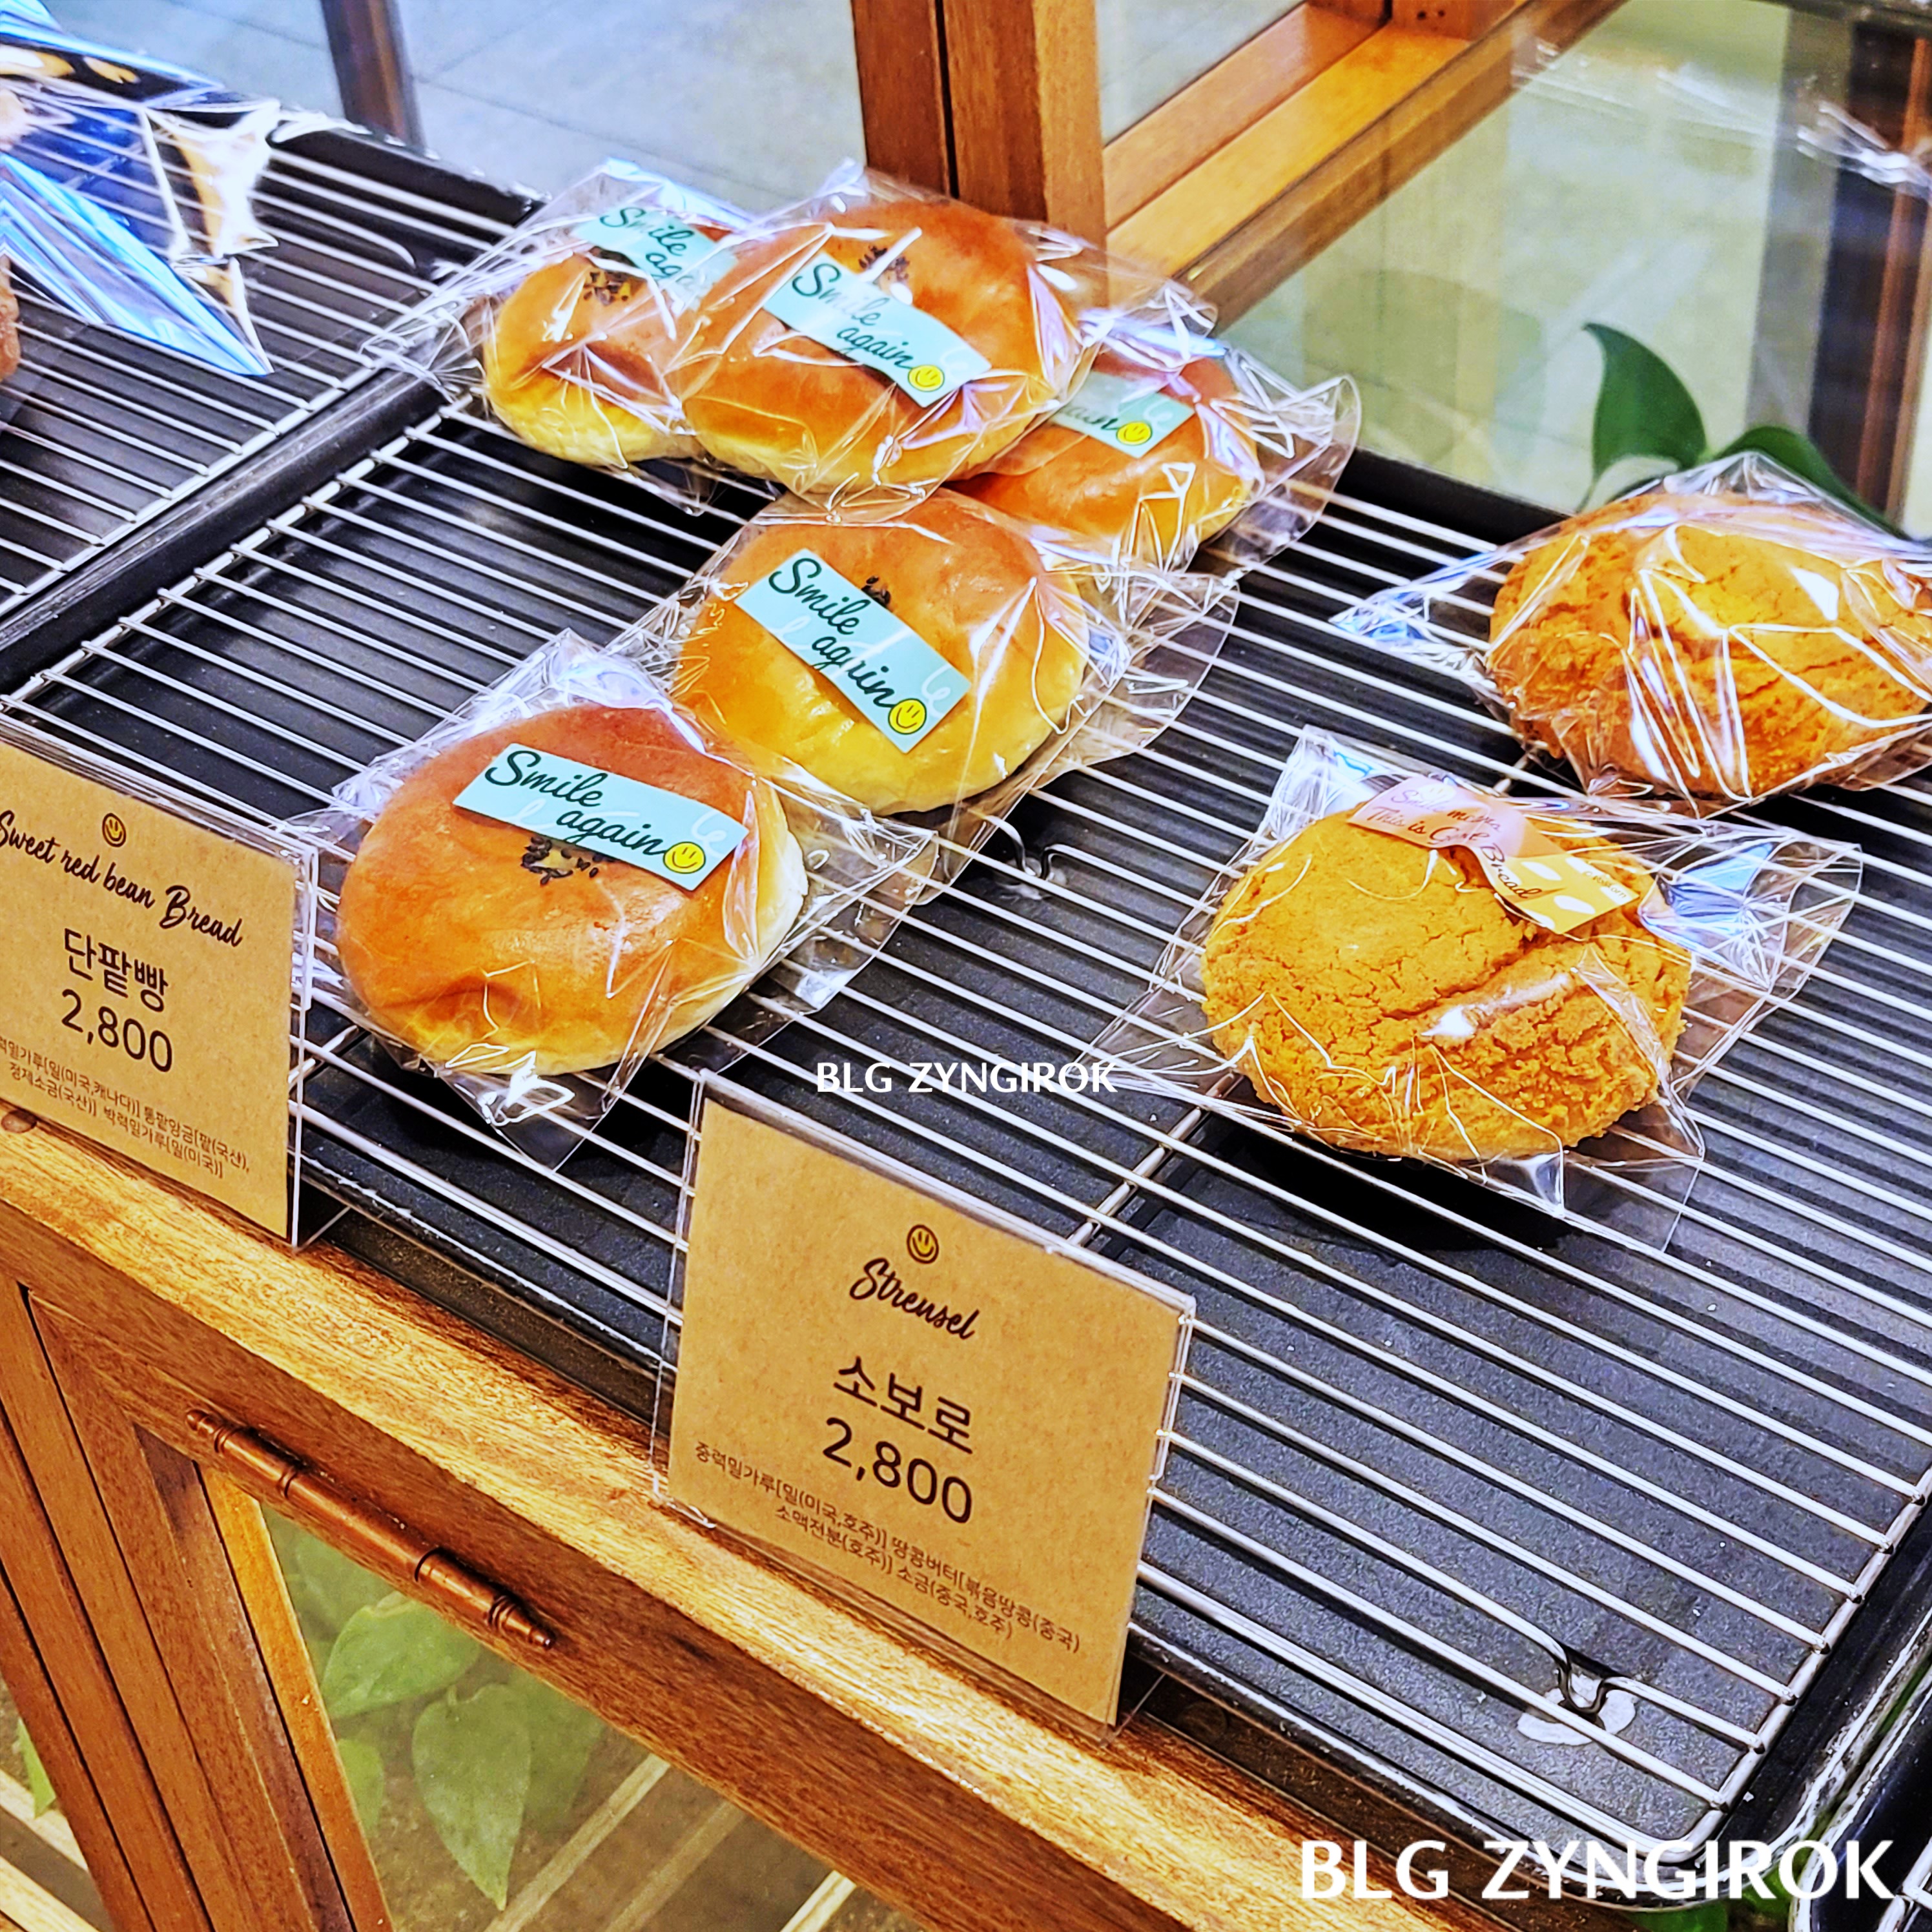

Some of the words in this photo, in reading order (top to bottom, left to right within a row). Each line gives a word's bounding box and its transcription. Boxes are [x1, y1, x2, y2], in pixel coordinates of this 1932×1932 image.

[599, 207, 694, 256] Sile
[837, 327, 914, 369] again
[768, 557, 870, 635] Smile
[811, 636, 897, 708] again
[485, 750, 608, 807] Smile
[556, 810, 668, 856] again
[1408, 821, 1426, 834] is
[0, 809, 61, 864] Sweet
[61, 851, 102, 884] red
[103, 862, 156, 909] bean
[159, 884, 245, 947] Bread
[1481, 843, 1543, 899] Bread
[63, 927, 170, 1012] 단팥빵
[61, 989, 173, 1073] 2,800
[833, 1356, 974, 1454] 소보로
[822, 1417, 973, 1525] 2,800
